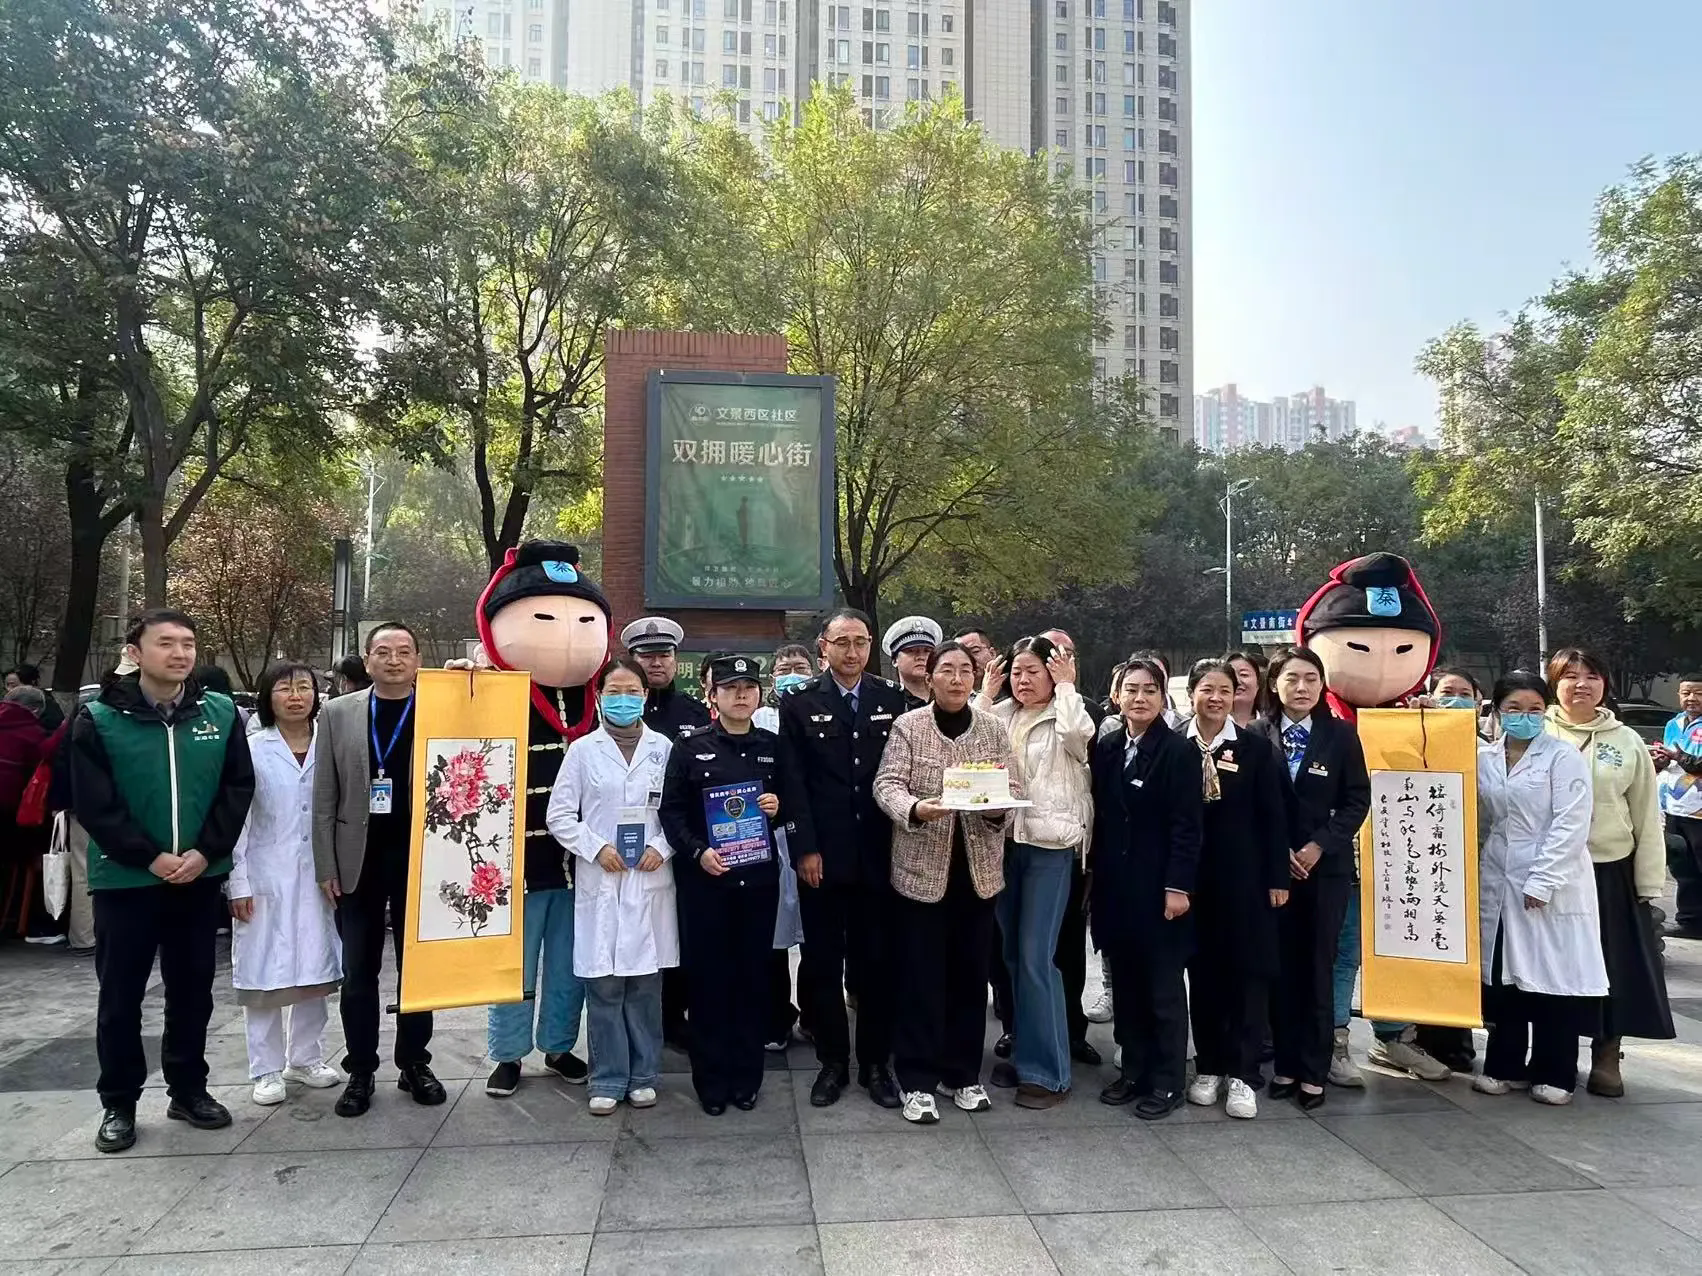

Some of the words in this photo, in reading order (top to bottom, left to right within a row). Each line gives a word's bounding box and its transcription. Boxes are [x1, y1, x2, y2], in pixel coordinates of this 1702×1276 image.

[716, 407, 798, 422] 文景西区社区
[672, 439, 812, 467] 双拥暖心街
